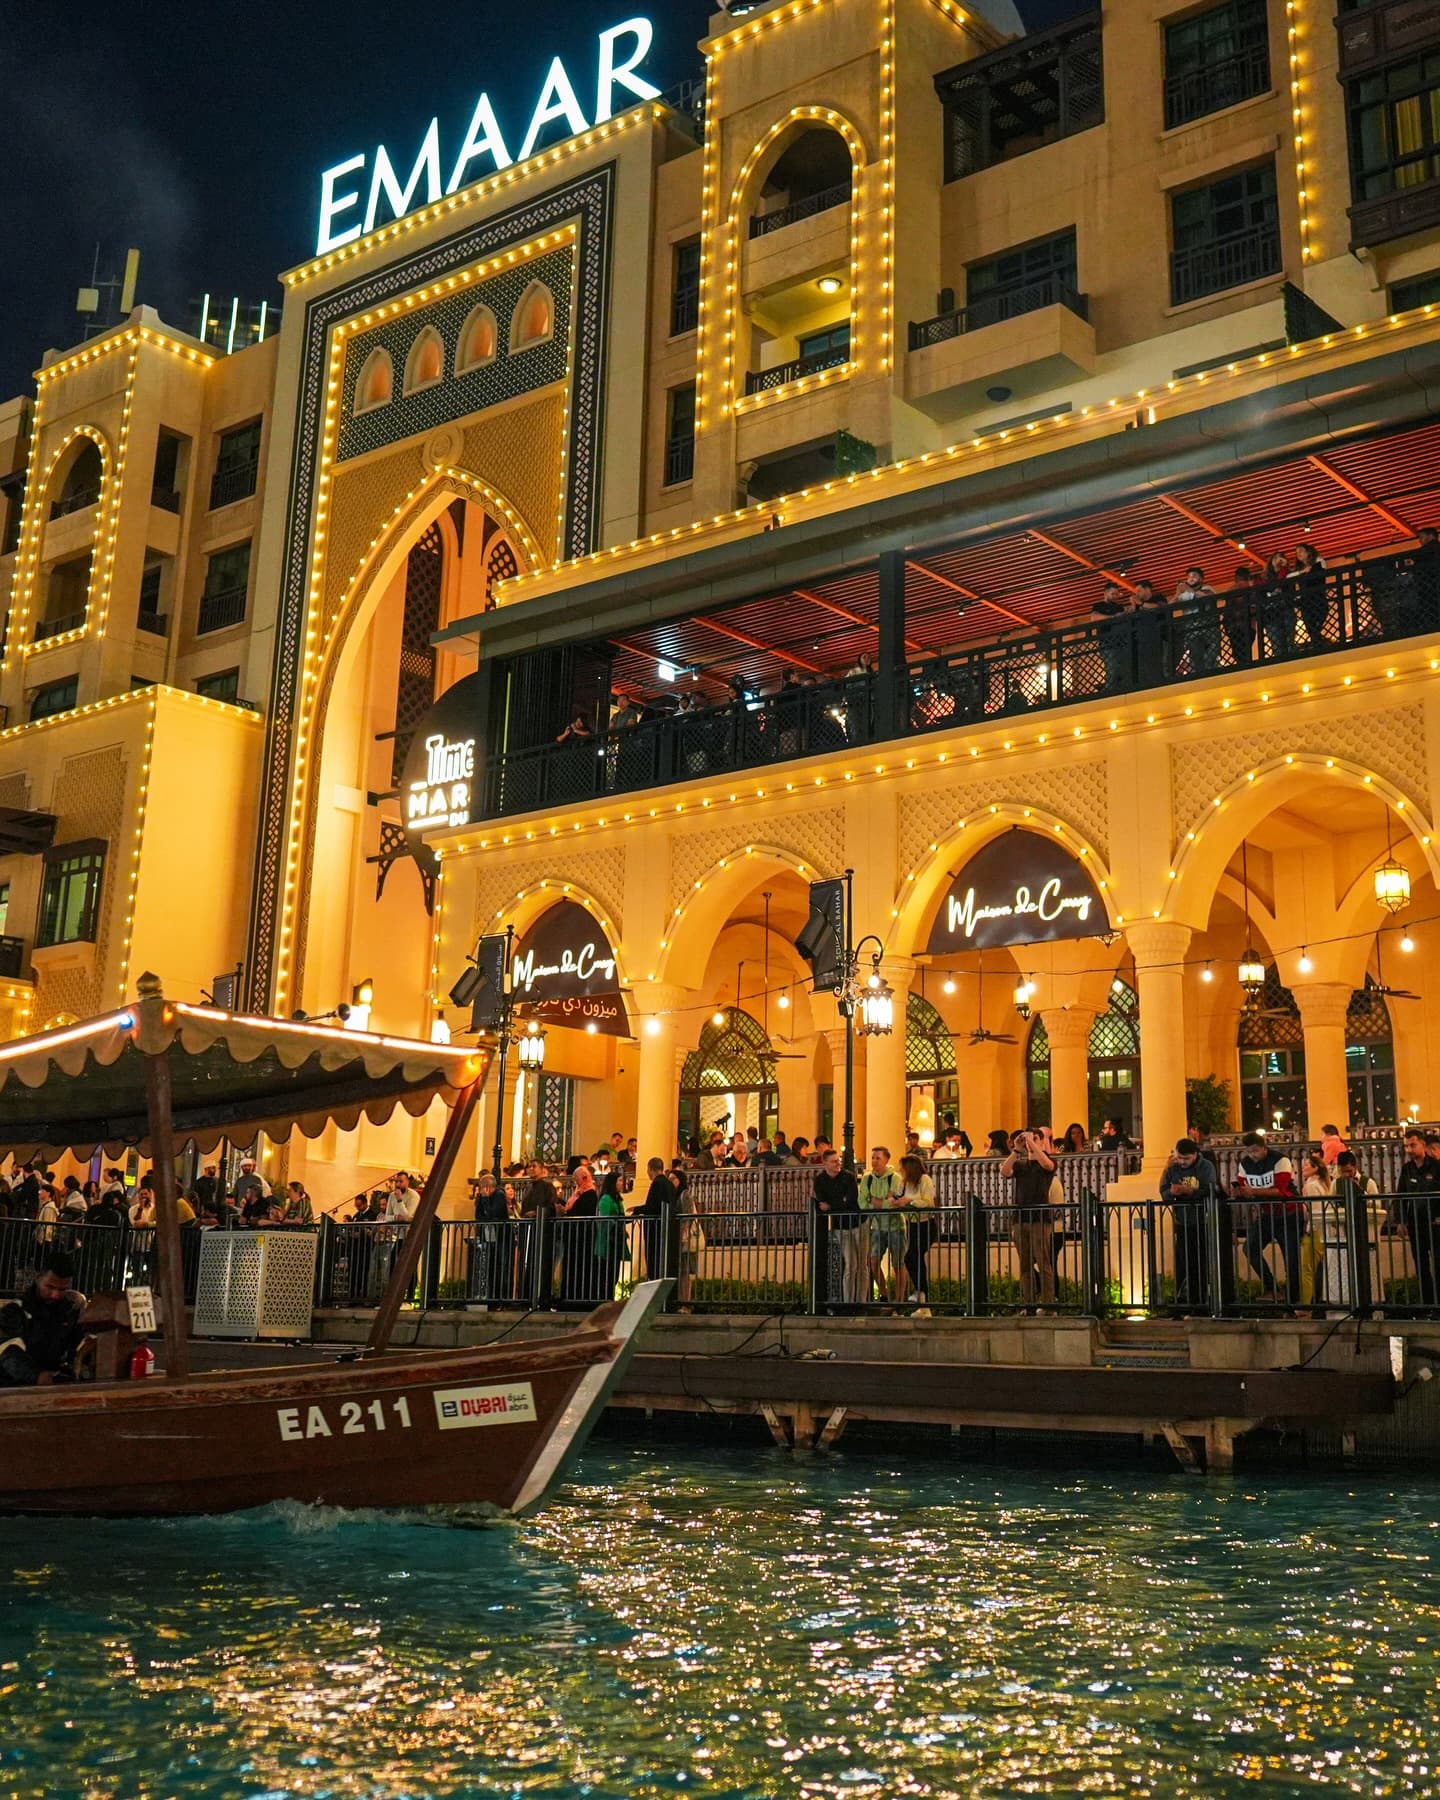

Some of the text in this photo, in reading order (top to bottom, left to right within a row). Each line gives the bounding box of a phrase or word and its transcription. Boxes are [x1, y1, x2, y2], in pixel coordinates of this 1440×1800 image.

[316, 16, 663, 256] EMAAR
[948, 878, 1092, 937] Maison de Curry
[513, 949, 559, 992] Maison
[560, 949, 578, 973] de
[583, 999, 618, 1018] ميزون
[133, 1311, 154, 1329] 211
[277, 1396, 412, 1440] EA 211
[460, 1395, 508, 1416] DUBAI
